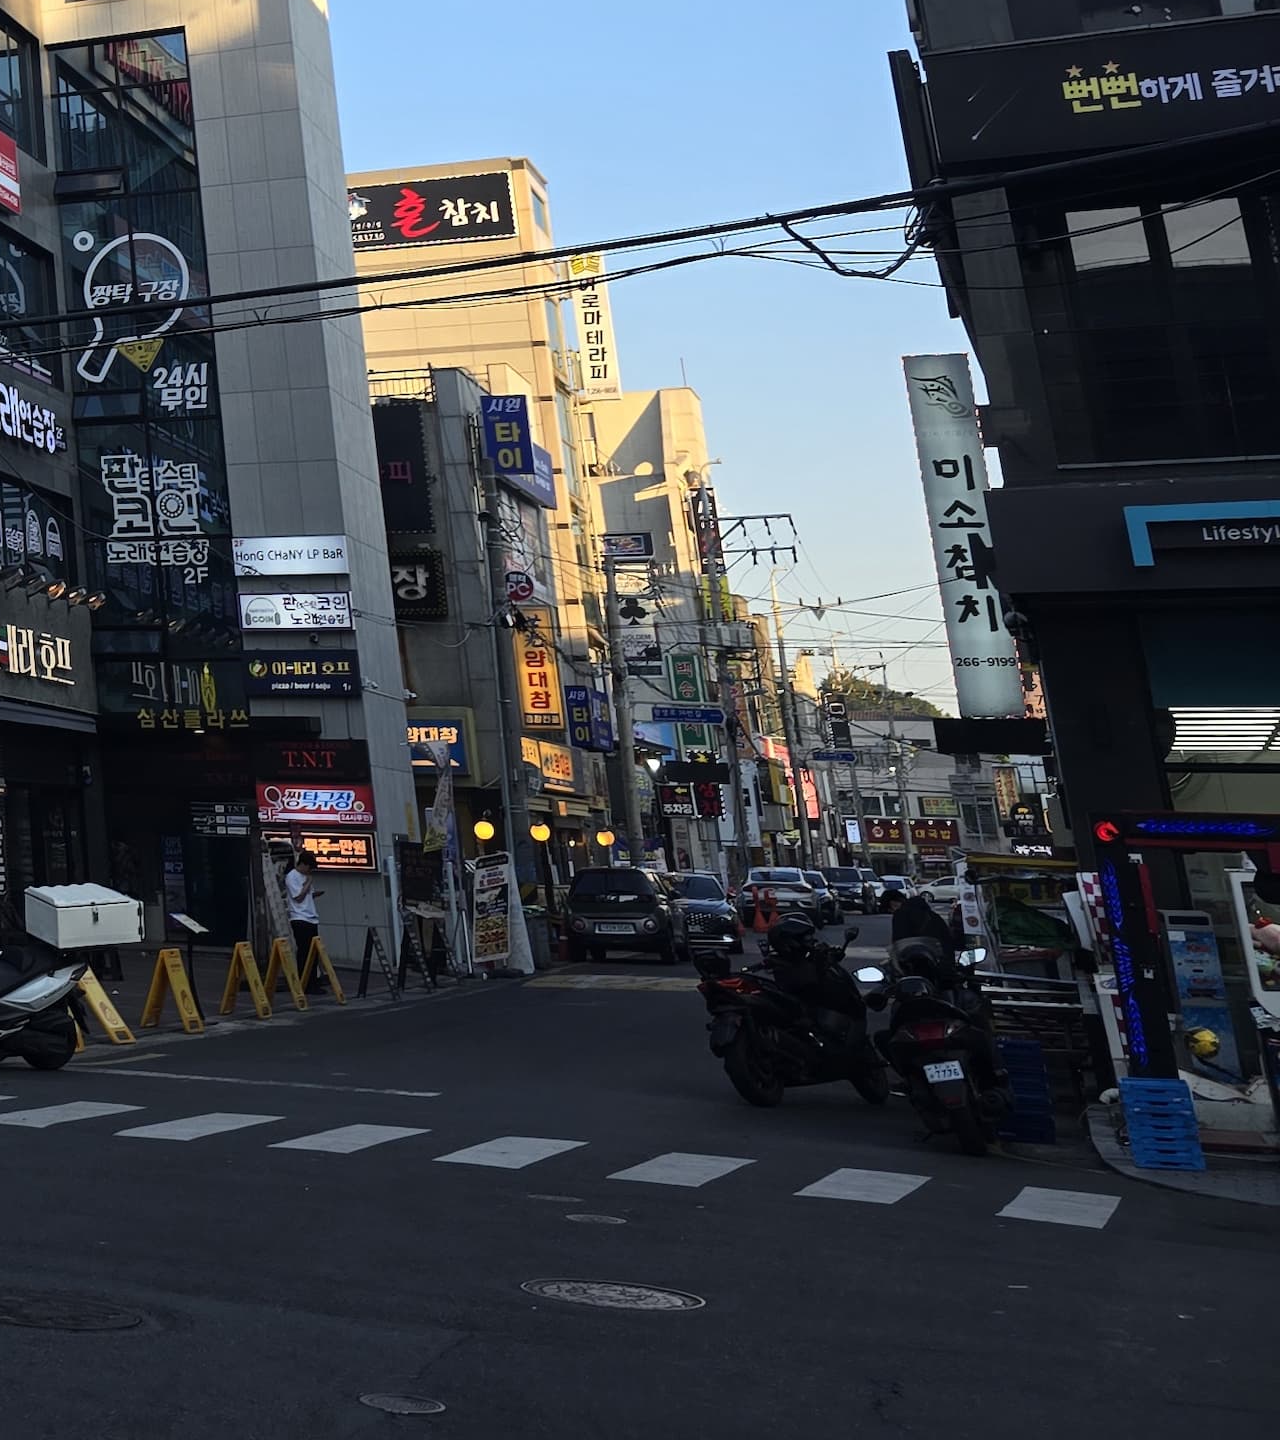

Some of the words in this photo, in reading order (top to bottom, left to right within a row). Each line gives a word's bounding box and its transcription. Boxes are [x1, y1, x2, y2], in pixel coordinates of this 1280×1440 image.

[1062, 68, 1204, 114] 뻔뻔하게
[91, 279, 180, 307] 짱탁구장
[152, 361, 208, 390] 24시
[160, 385, 209, 412] 무인
[488, 397, 521, 414] 시원
[494, 421, 523, 470] 타이
[108, 488, 206, 538] 코인
[235, 549, 264, 562] HonG
[267, 549, 303, 561] CHaNY
[307, 548, 320, 560] LP
[323, 548, 344, 560] BaR
[184, 566, 209, 584] 2F
[506, 581, 530, 597] PC
[251, 614, 274, 624] COIN
[40, 632, 76, 687] 호프
[321, 661, 352, 675] 호프
[955, 656, 1017, 668] 266-9199
[572, 707, 590, 743] 타이
[281, 751, 337, 769] T.N.T
[286, 790, 354, 810] 짱탁구장
[663, 802, 694, 815] 주차장
